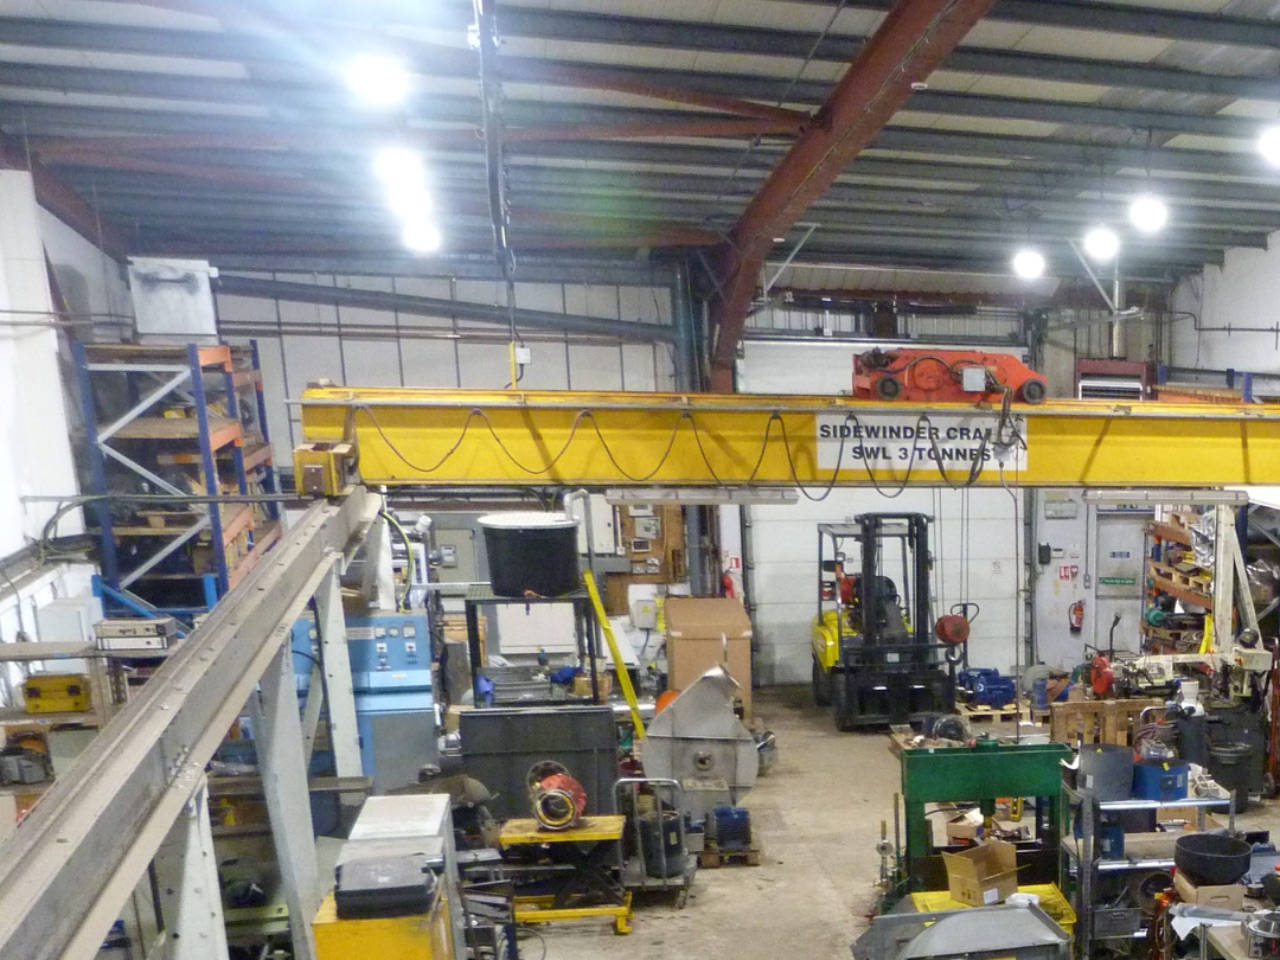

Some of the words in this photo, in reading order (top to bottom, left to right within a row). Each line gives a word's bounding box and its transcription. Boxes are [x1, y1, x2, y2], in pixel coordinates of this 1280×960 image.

[819, 424, 940, 440] SIDEWINDER
[851, 447, 892, 461] SWL
[898, 449, 909, 461] 3
[916, 448, 992, 462] TONNES
